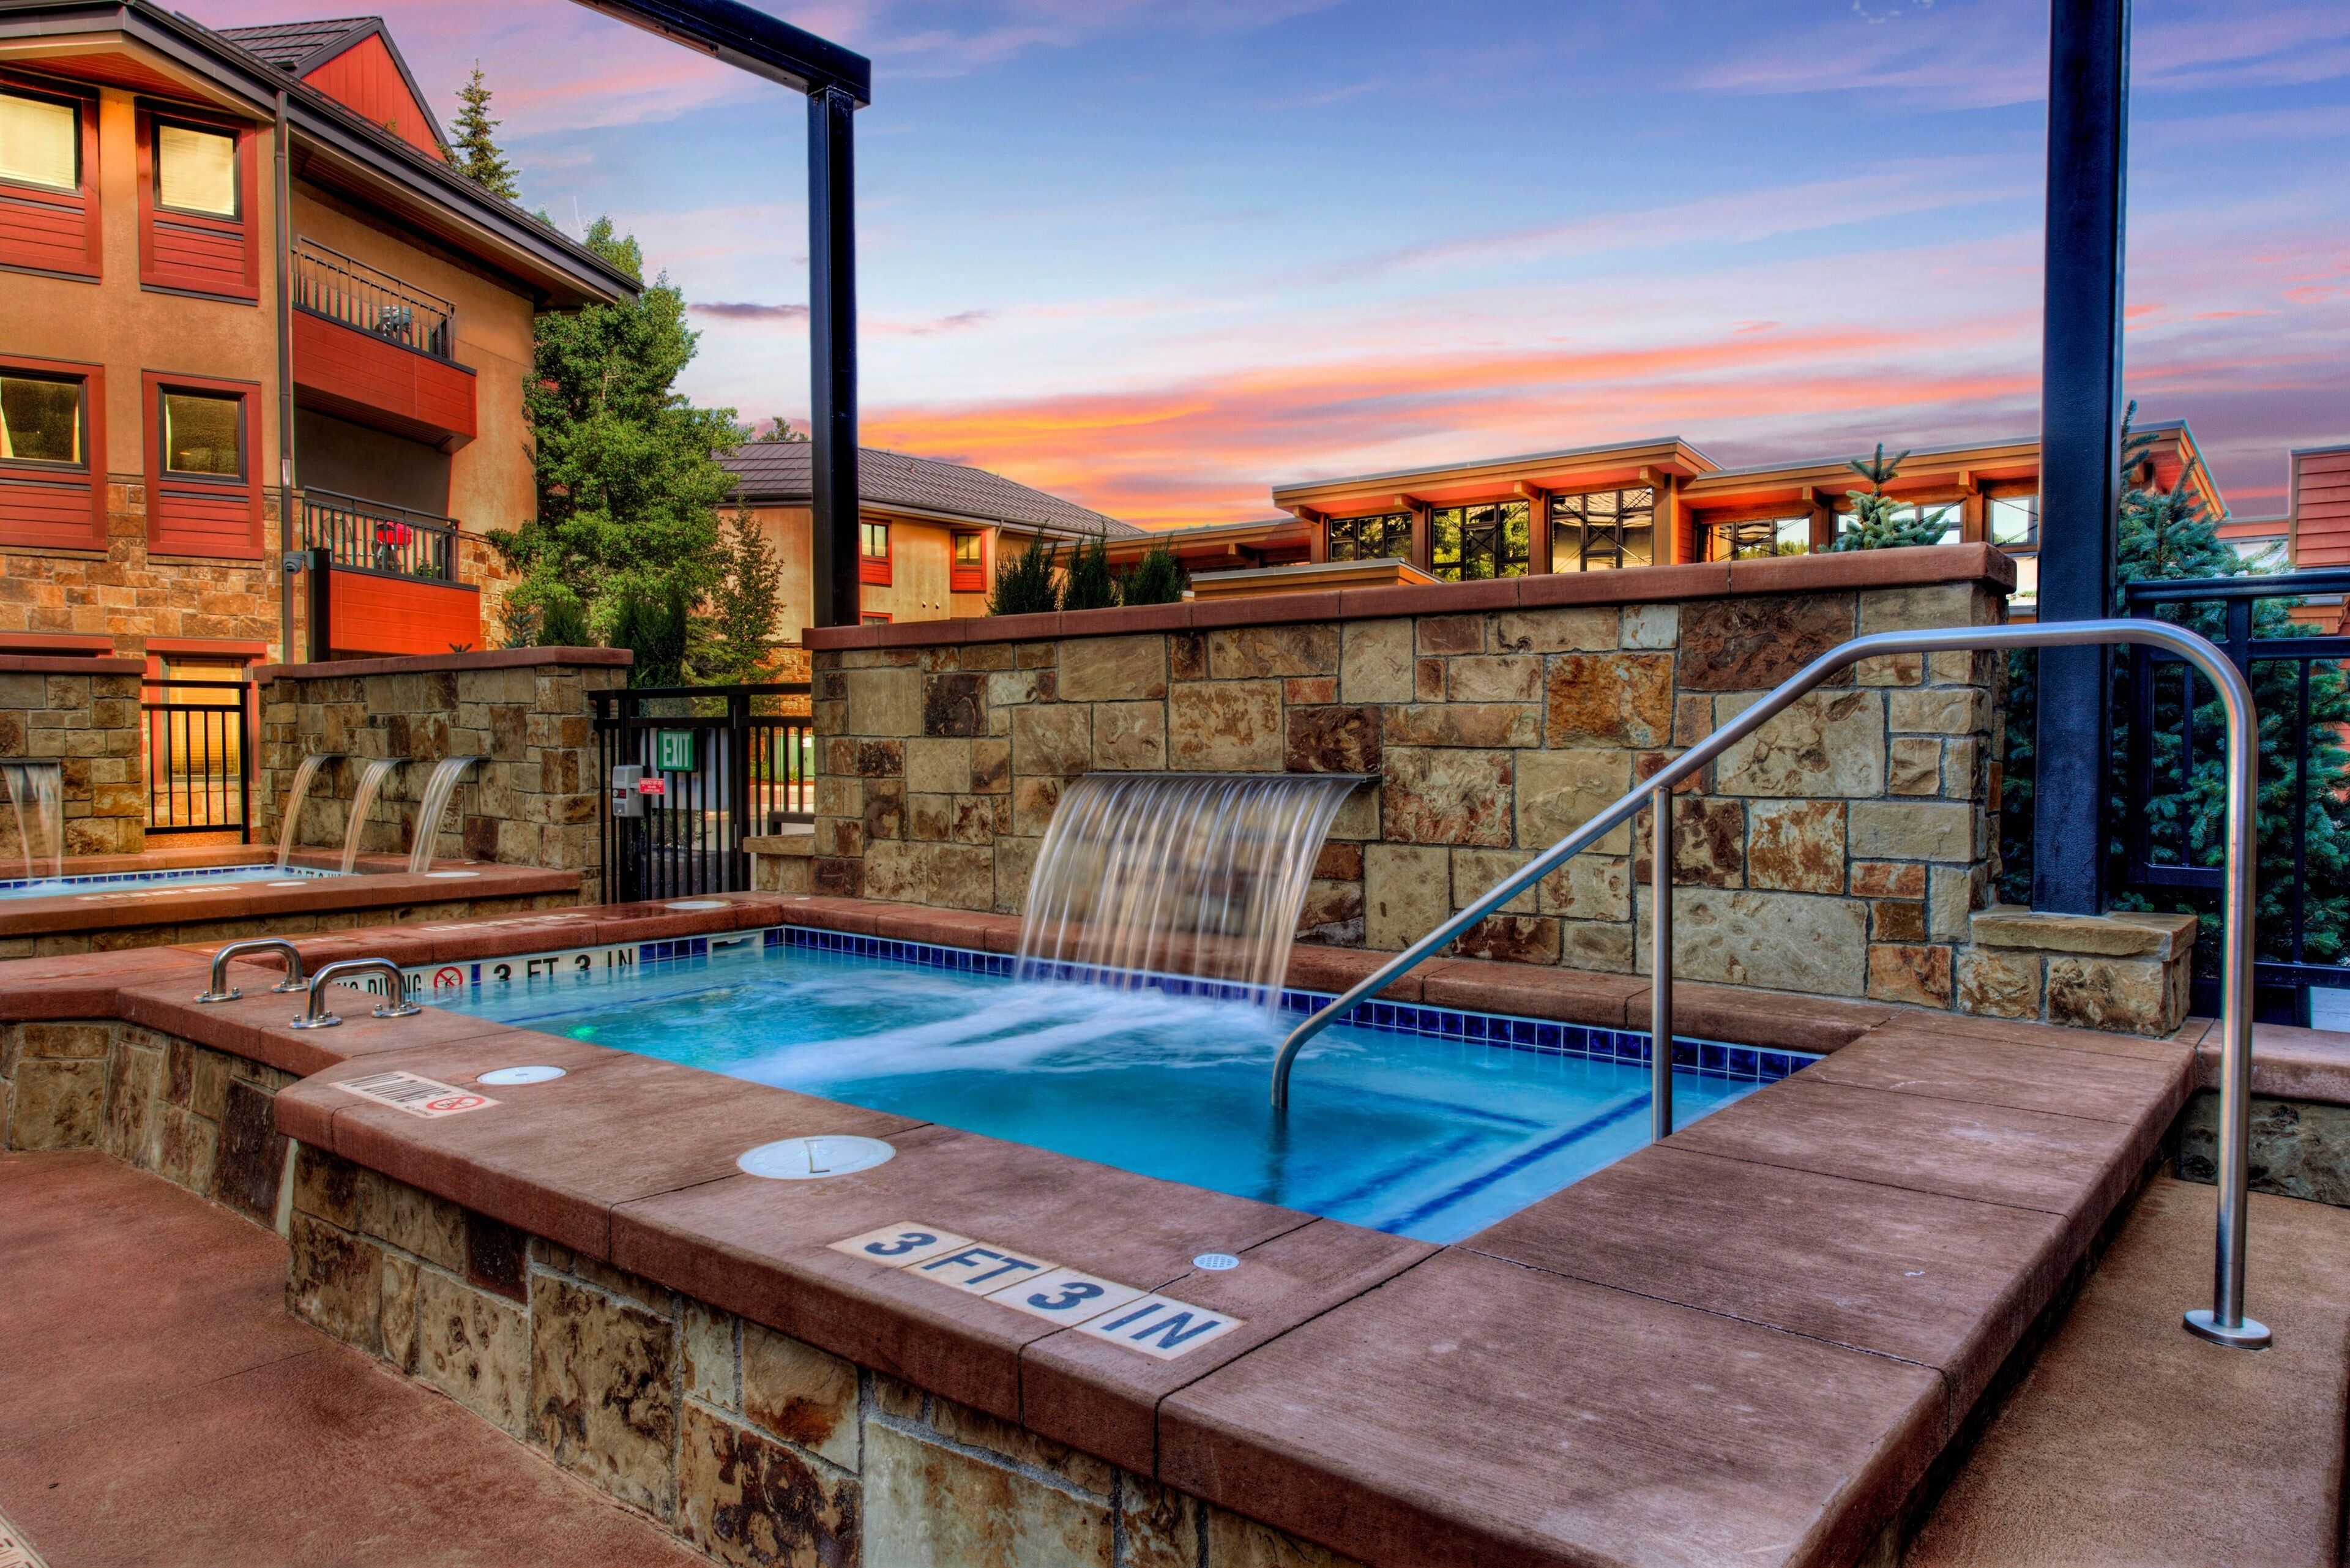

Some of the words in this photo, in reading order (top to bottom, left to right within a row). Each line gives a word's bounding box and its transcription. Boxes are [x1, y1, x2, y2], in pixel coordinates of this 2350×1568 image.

[663, 734, 691, 767] EXIT
[494, 964, 512, 982] 3
[528, 957, 559, 978] FT
[575, 954, 591, 971] 3
[608, 949, 633, 968] IN
[361, 1080, 451, 1102] DIVING
[864, 1232, 938, 1256] 3
[921, 1247, 1039, 1285] FT
[1027, 1282, 1105, 1310] 3
[1101, 1303, 1222, 1349] IN
